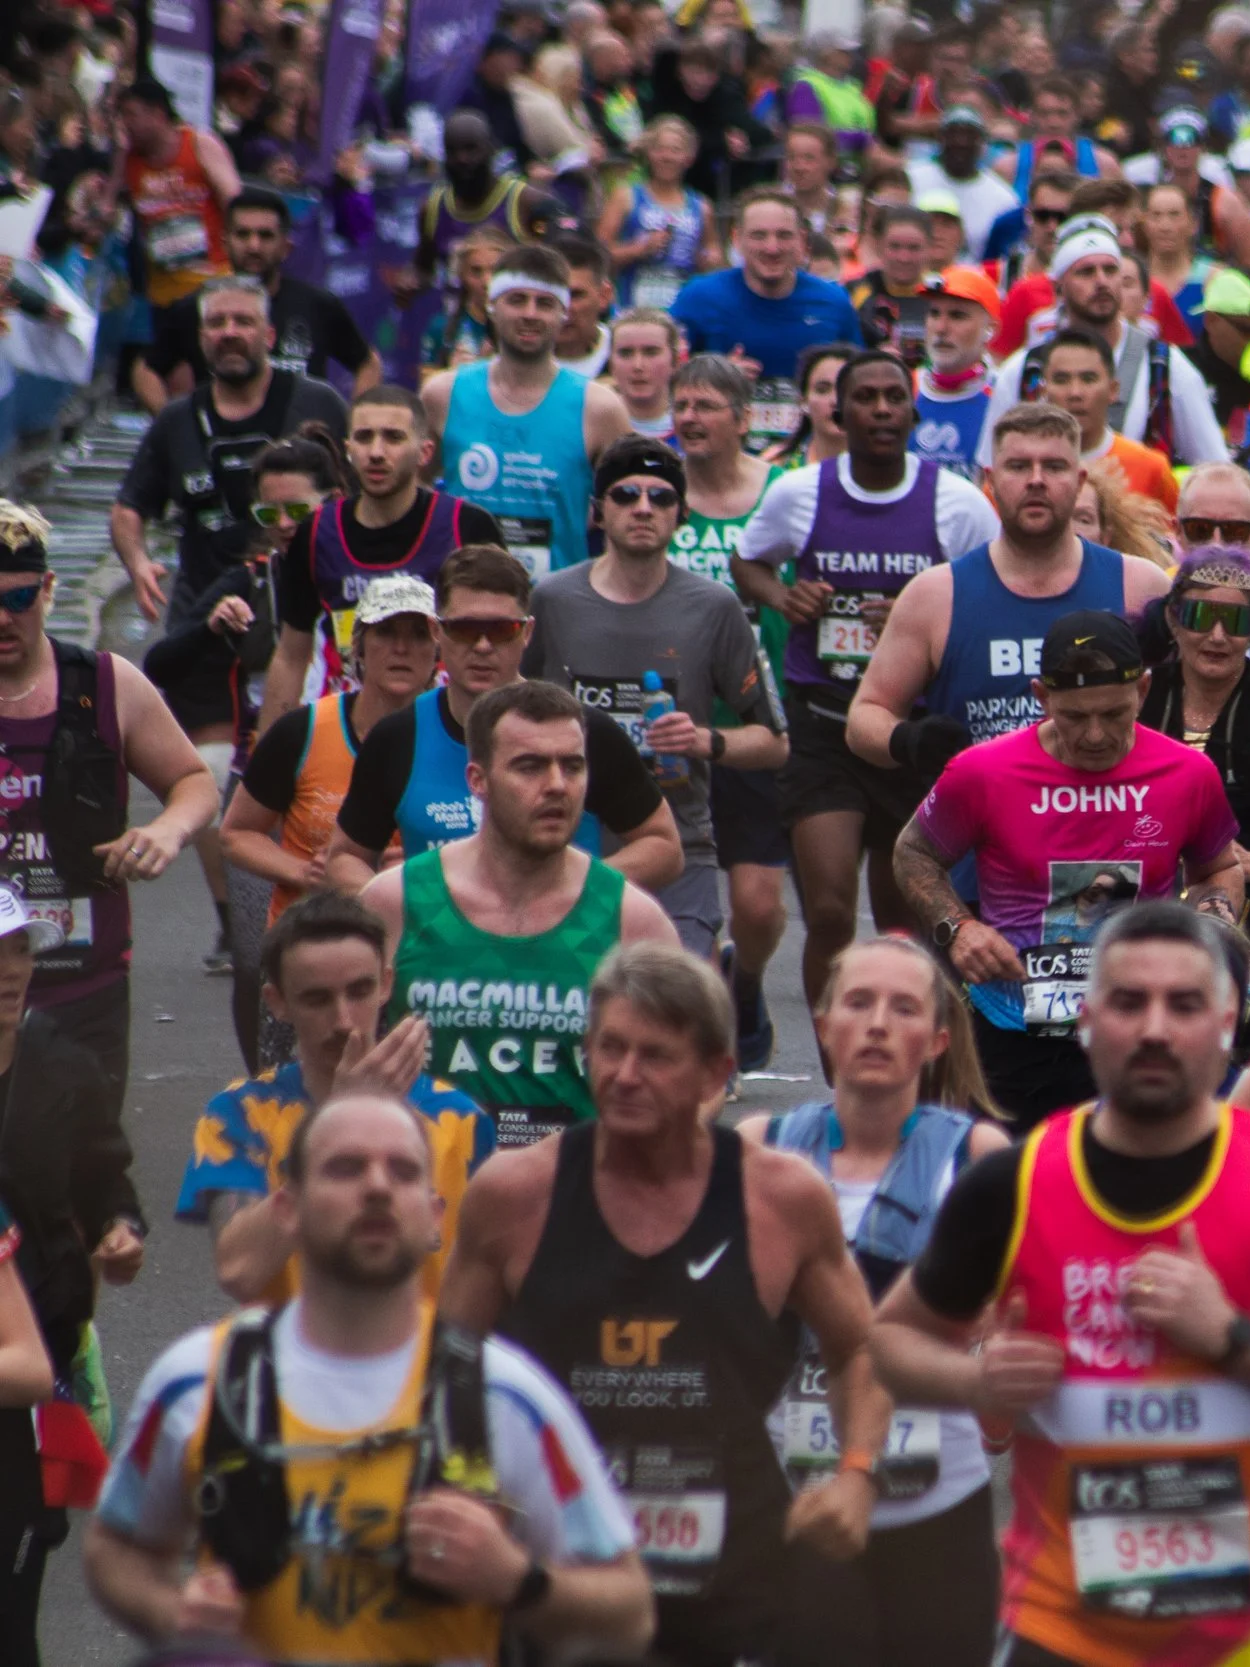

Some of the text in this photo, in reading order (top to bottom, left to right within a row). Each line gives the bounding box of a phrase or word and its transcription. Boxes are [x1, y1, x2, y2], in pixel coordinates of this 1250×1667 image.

[815, 552, 879, 573] TEAM
[574, 680, 612, 708] tcs
[616, 683, 640, 692] TATA
[1030, 785, 1150, 815] JOHNY
[1026, 952, 1068, 978] tcs
[406, 979, 591, 1016] MACMILLA
[498, 1112, 529, 1122] TATA
[570, 1371, 706, 1387] EVERYWHERE
[1106, 1390, 1201, 1434] ROB
[1115, 1519, 1216, 1572] 9563
